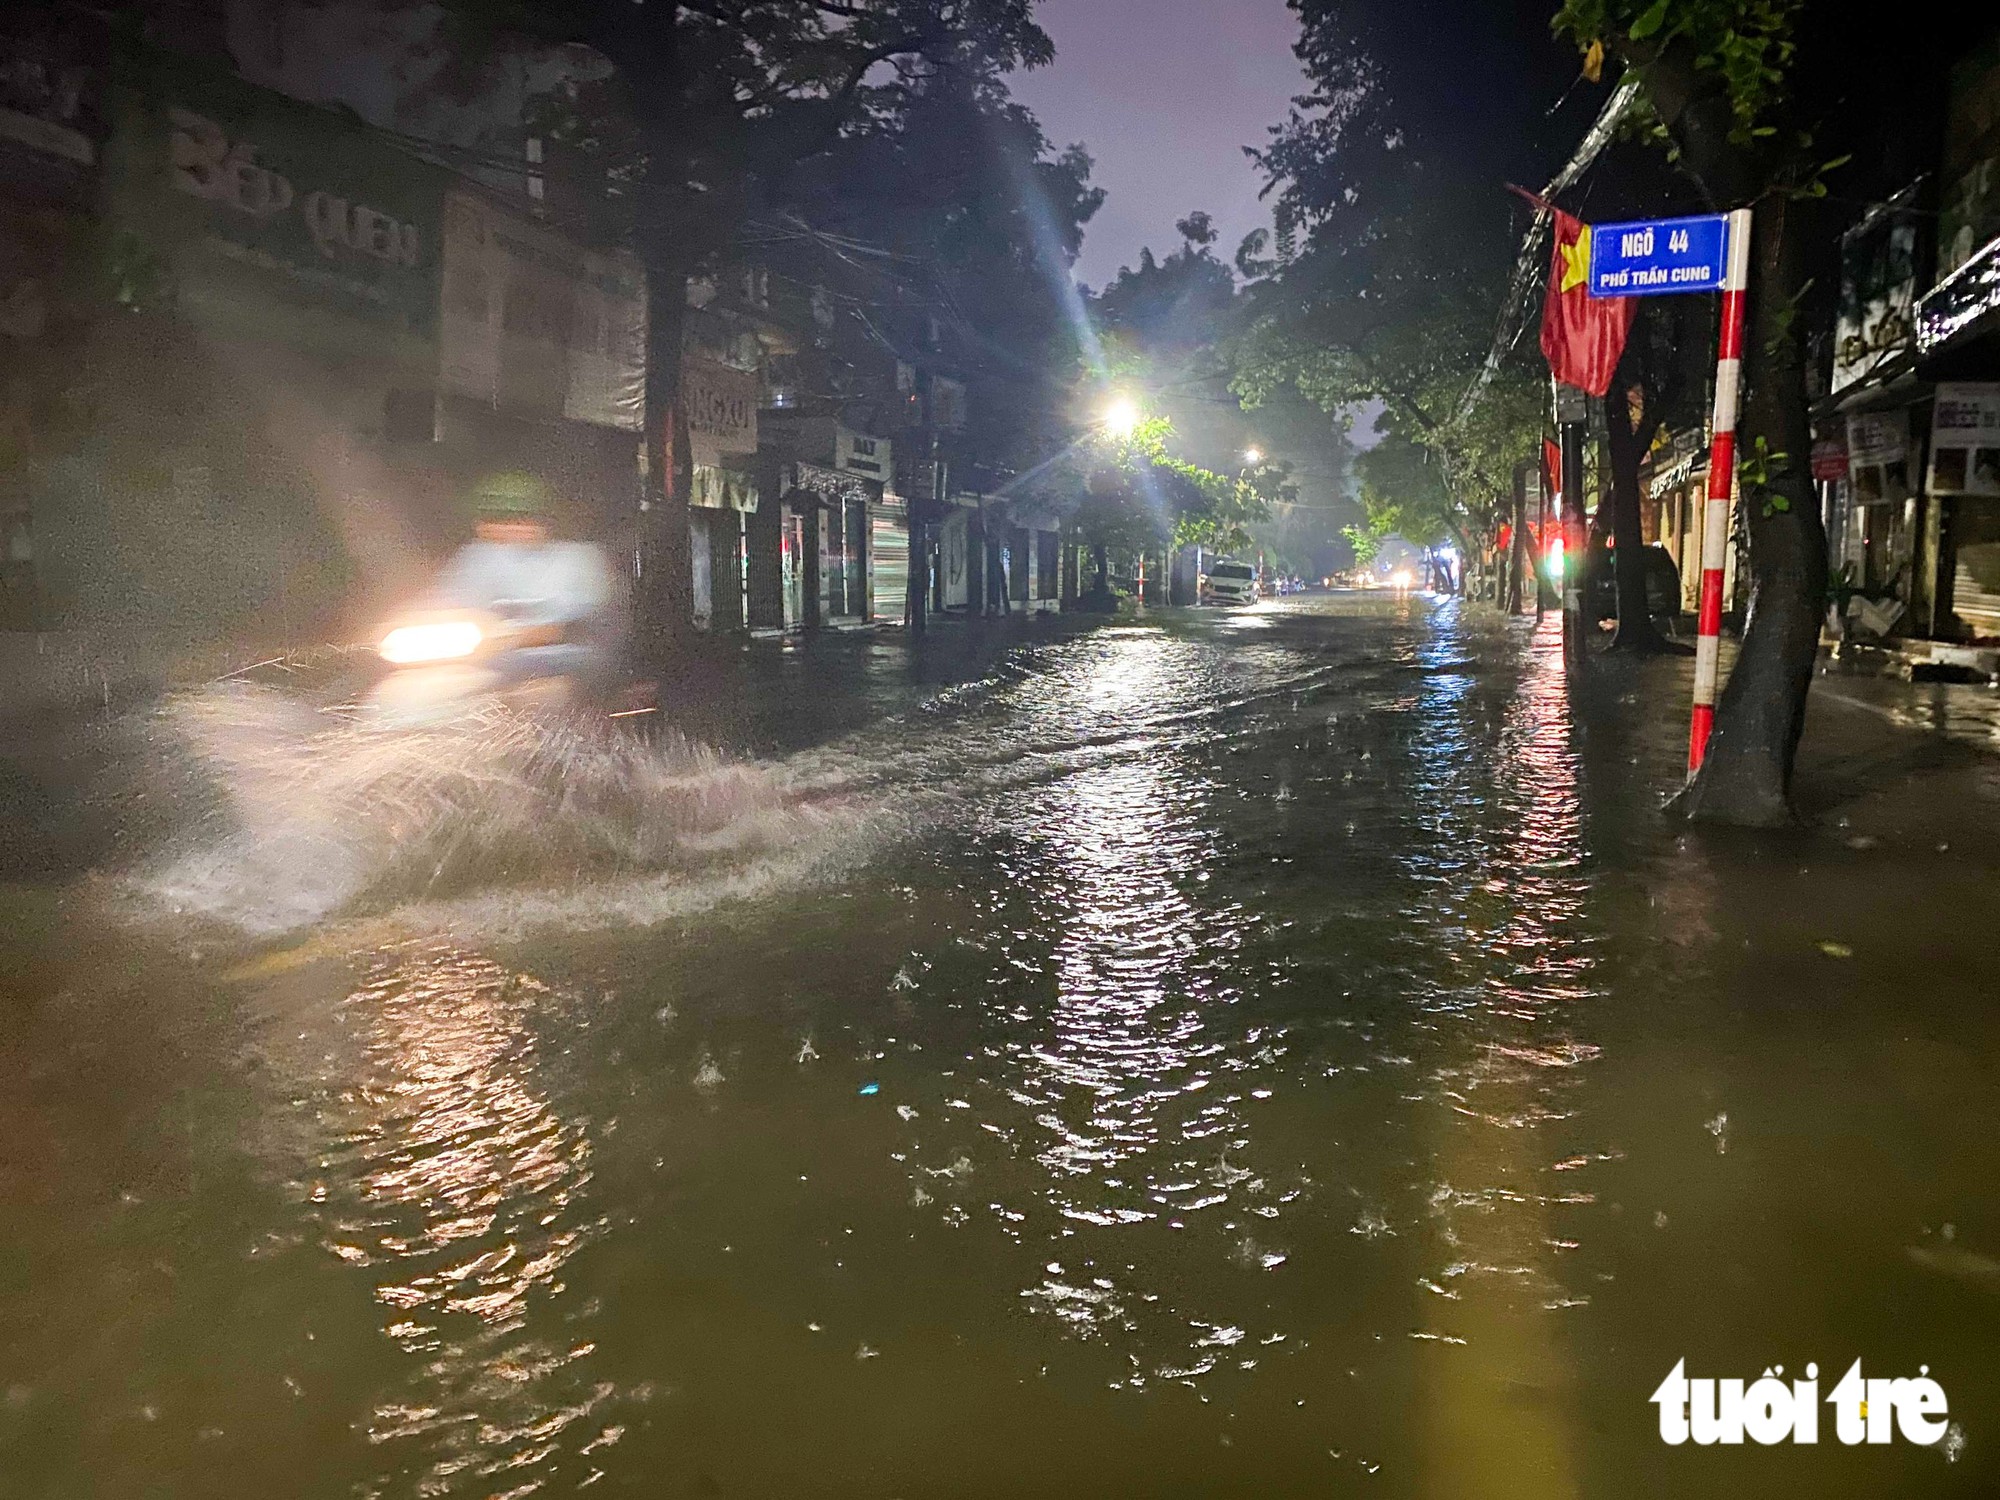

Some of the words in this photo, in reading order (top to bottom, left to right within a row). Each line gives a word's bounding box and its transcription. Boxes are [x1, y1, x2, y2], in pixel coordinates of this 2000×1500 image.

[1621, 226, 1654, 258] NGÕ
[1668, 229, 1689, 254] 44
[1600, 267, 1630, 287] PHỐ
[1671, 265, 1710, 282] CUNG
